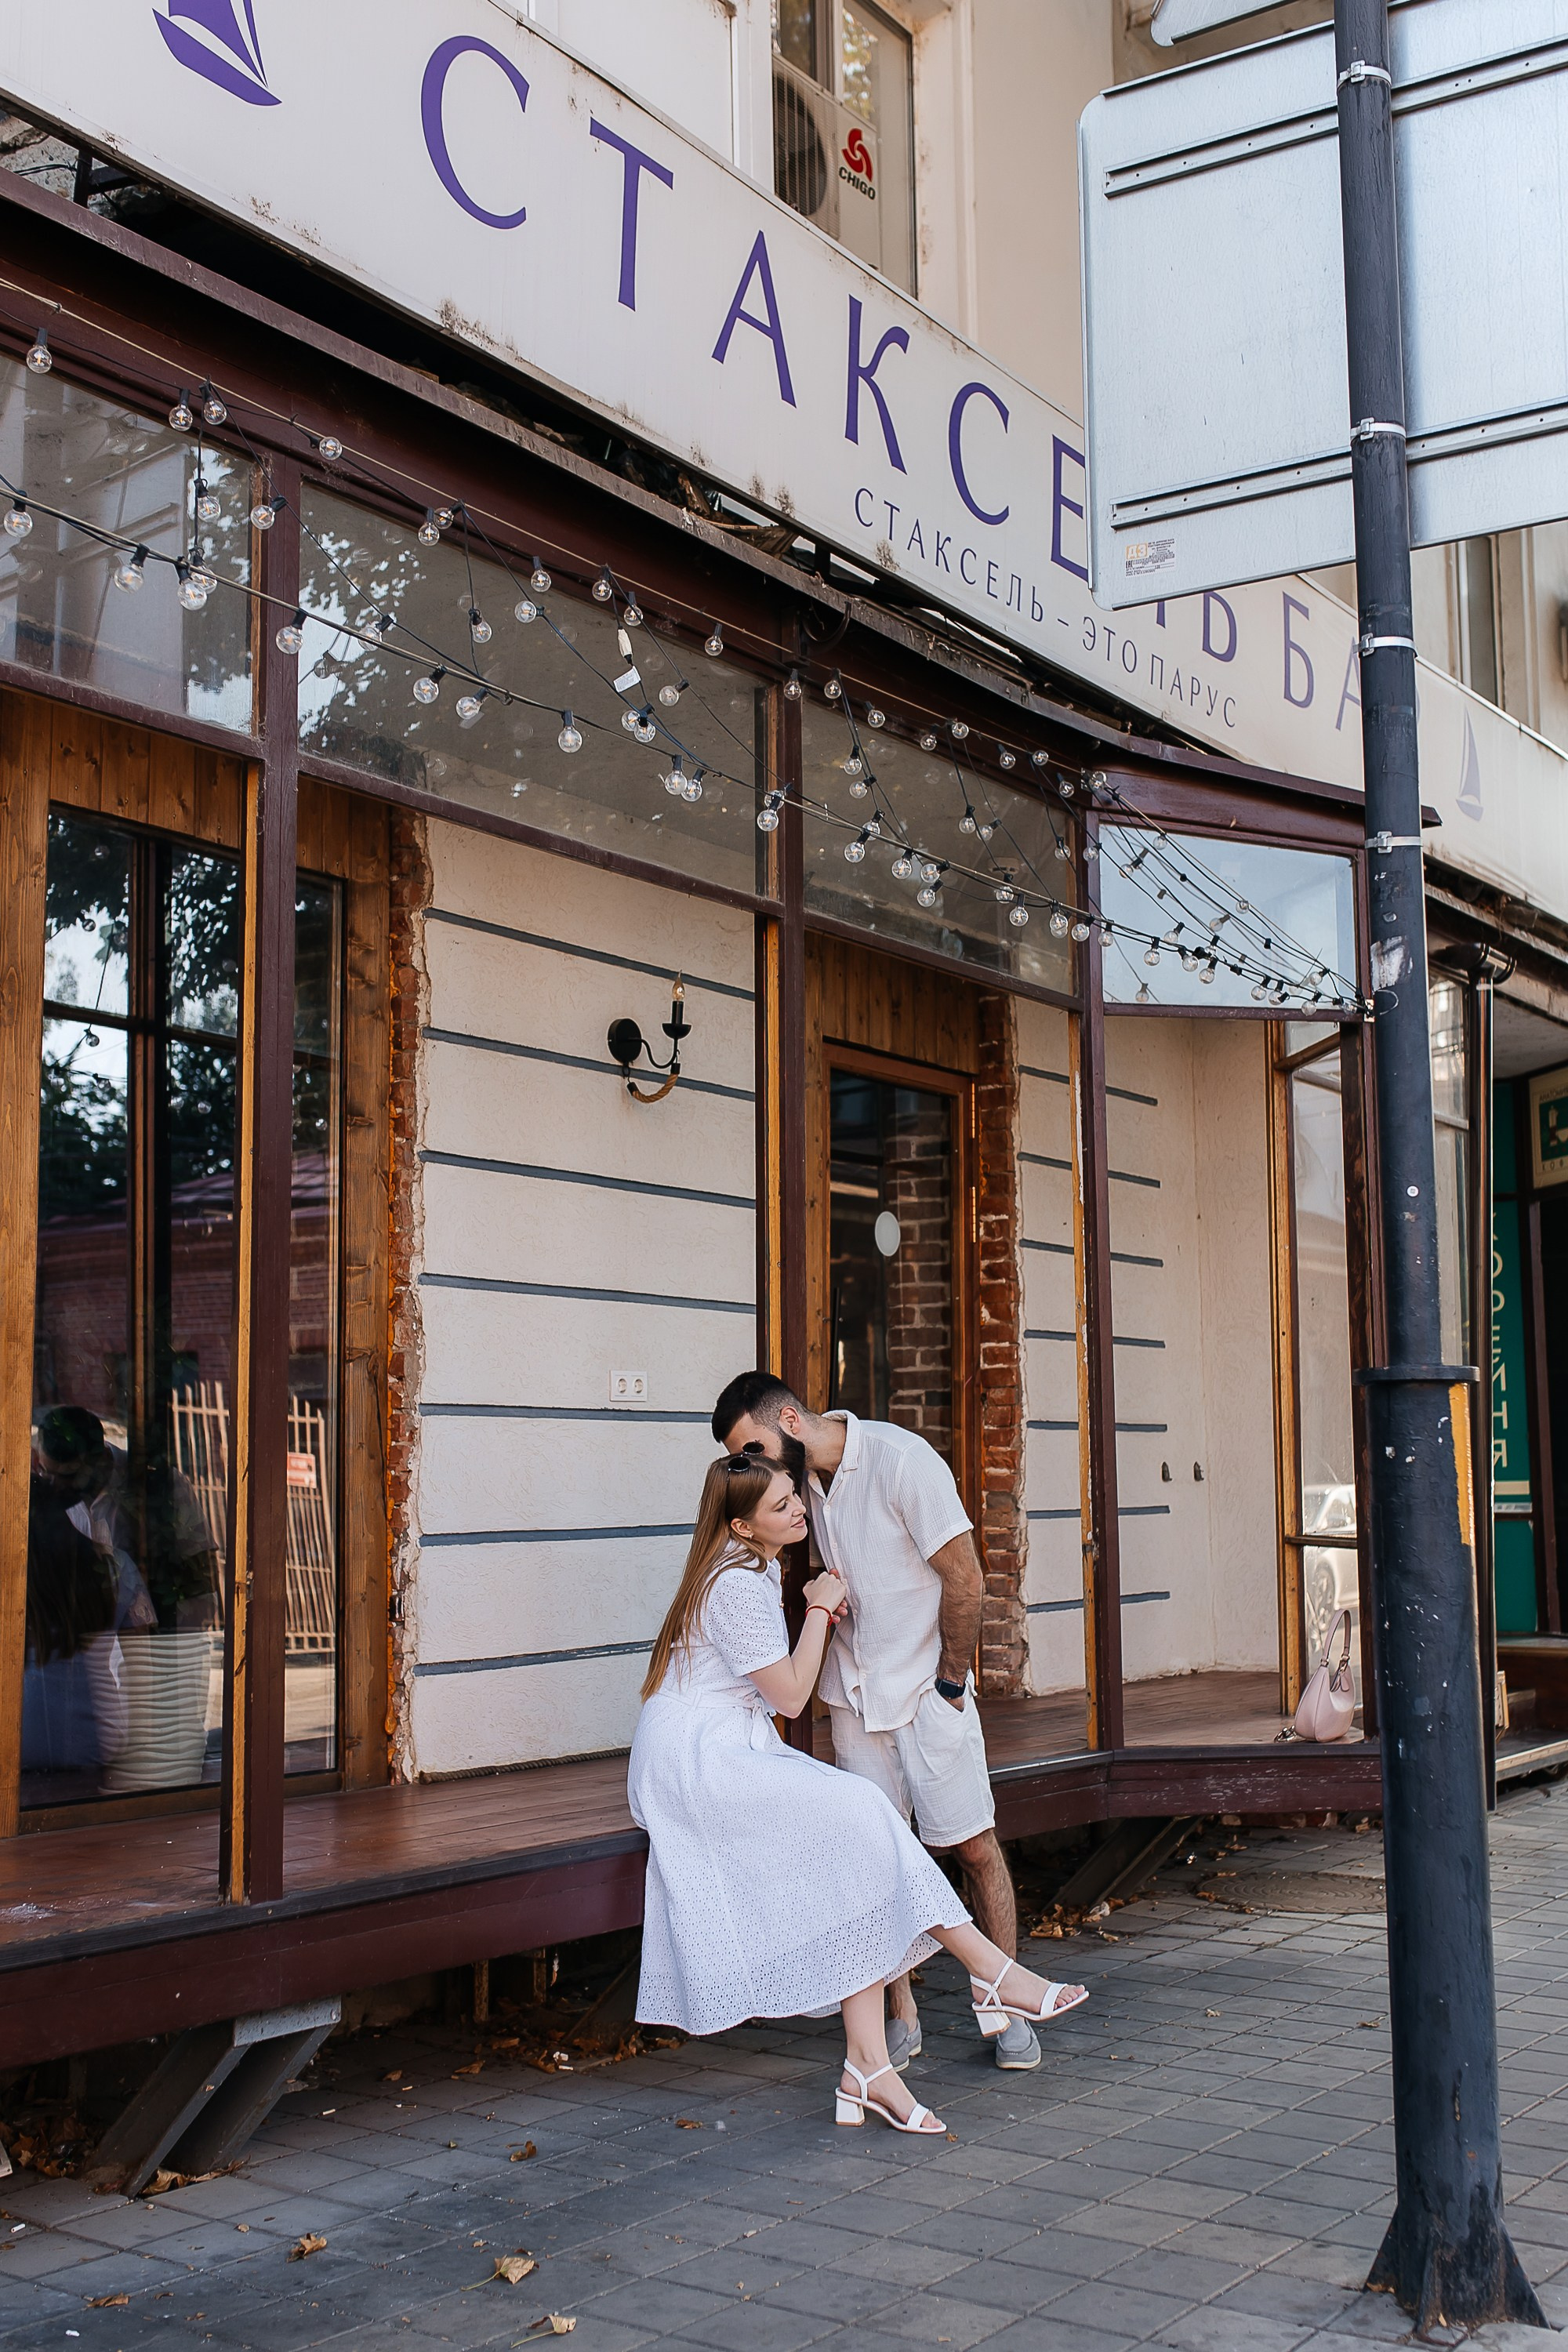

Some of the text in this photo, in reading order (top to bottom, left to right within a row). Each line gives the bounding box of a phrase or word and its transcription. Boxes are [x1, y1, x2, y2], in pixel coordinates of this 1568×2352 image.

[839, 165, 876, 201] CHIGO
[421, 34, 1237, 662] СТАКСЕЬ
[855, 488, 1044, 622] СТАКСЕЛЬ
[1083, 616, 1137, 673] ЭТО
[1150, 653, 1237, 729] ПАРУС
